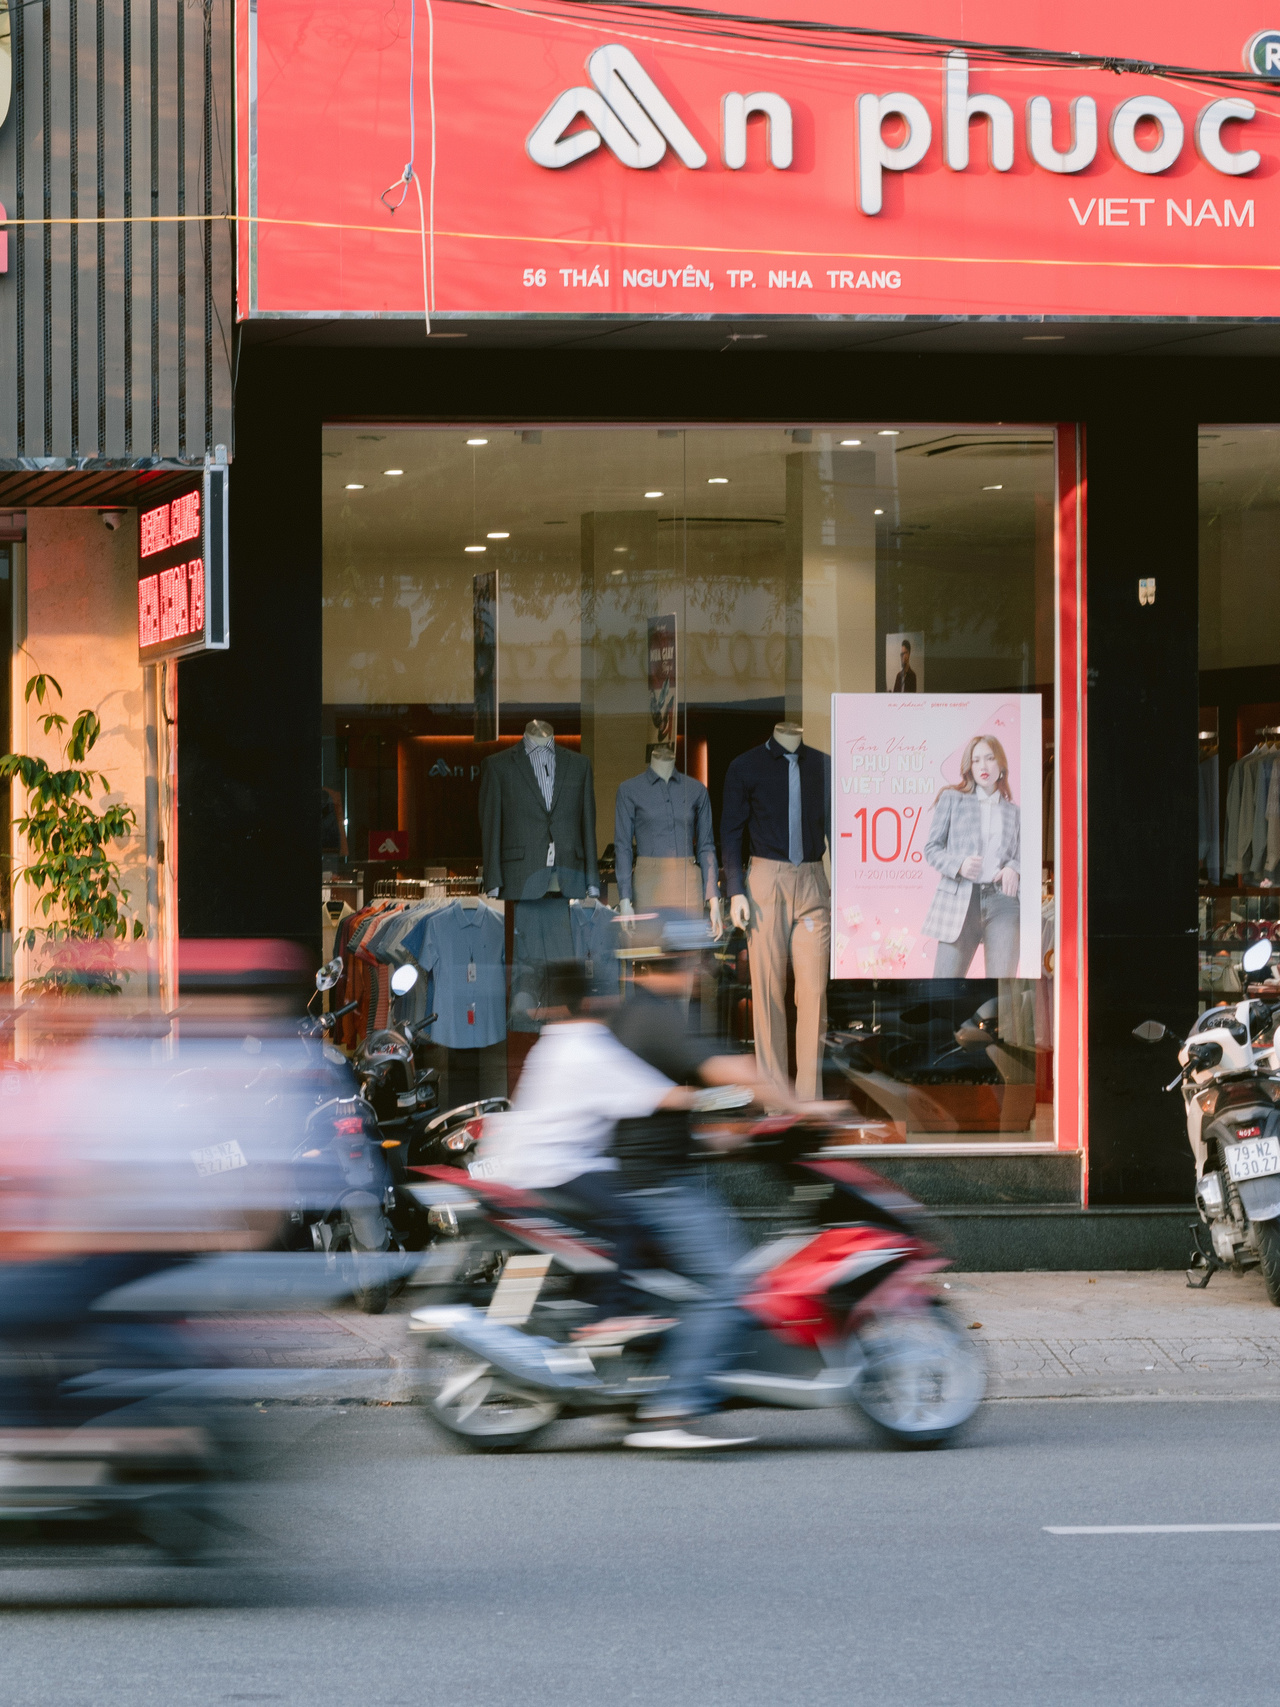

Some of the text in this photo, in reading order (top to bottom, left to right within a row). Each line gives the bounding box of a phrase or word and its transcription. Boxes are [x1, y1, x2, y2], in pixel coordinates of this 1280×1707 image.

[856, 49, 1262, 217] phuoc
[1068, 197, 1255, 228] VIET NAM
[522, 264, 902, 291] 56 THÁI NGUYÊN, TP. NHA TRANG
[886, 735, 928, 755] Vinh
[852, 754, 890, 776] PHỤ
[840, 774, 935, 798] VIỆT NAM
[840, 806, 923, 863] -10%
[854, 870, 923, 880] 17-20/10/2022
[1234, 1155, 1278, 1177] 430.27
